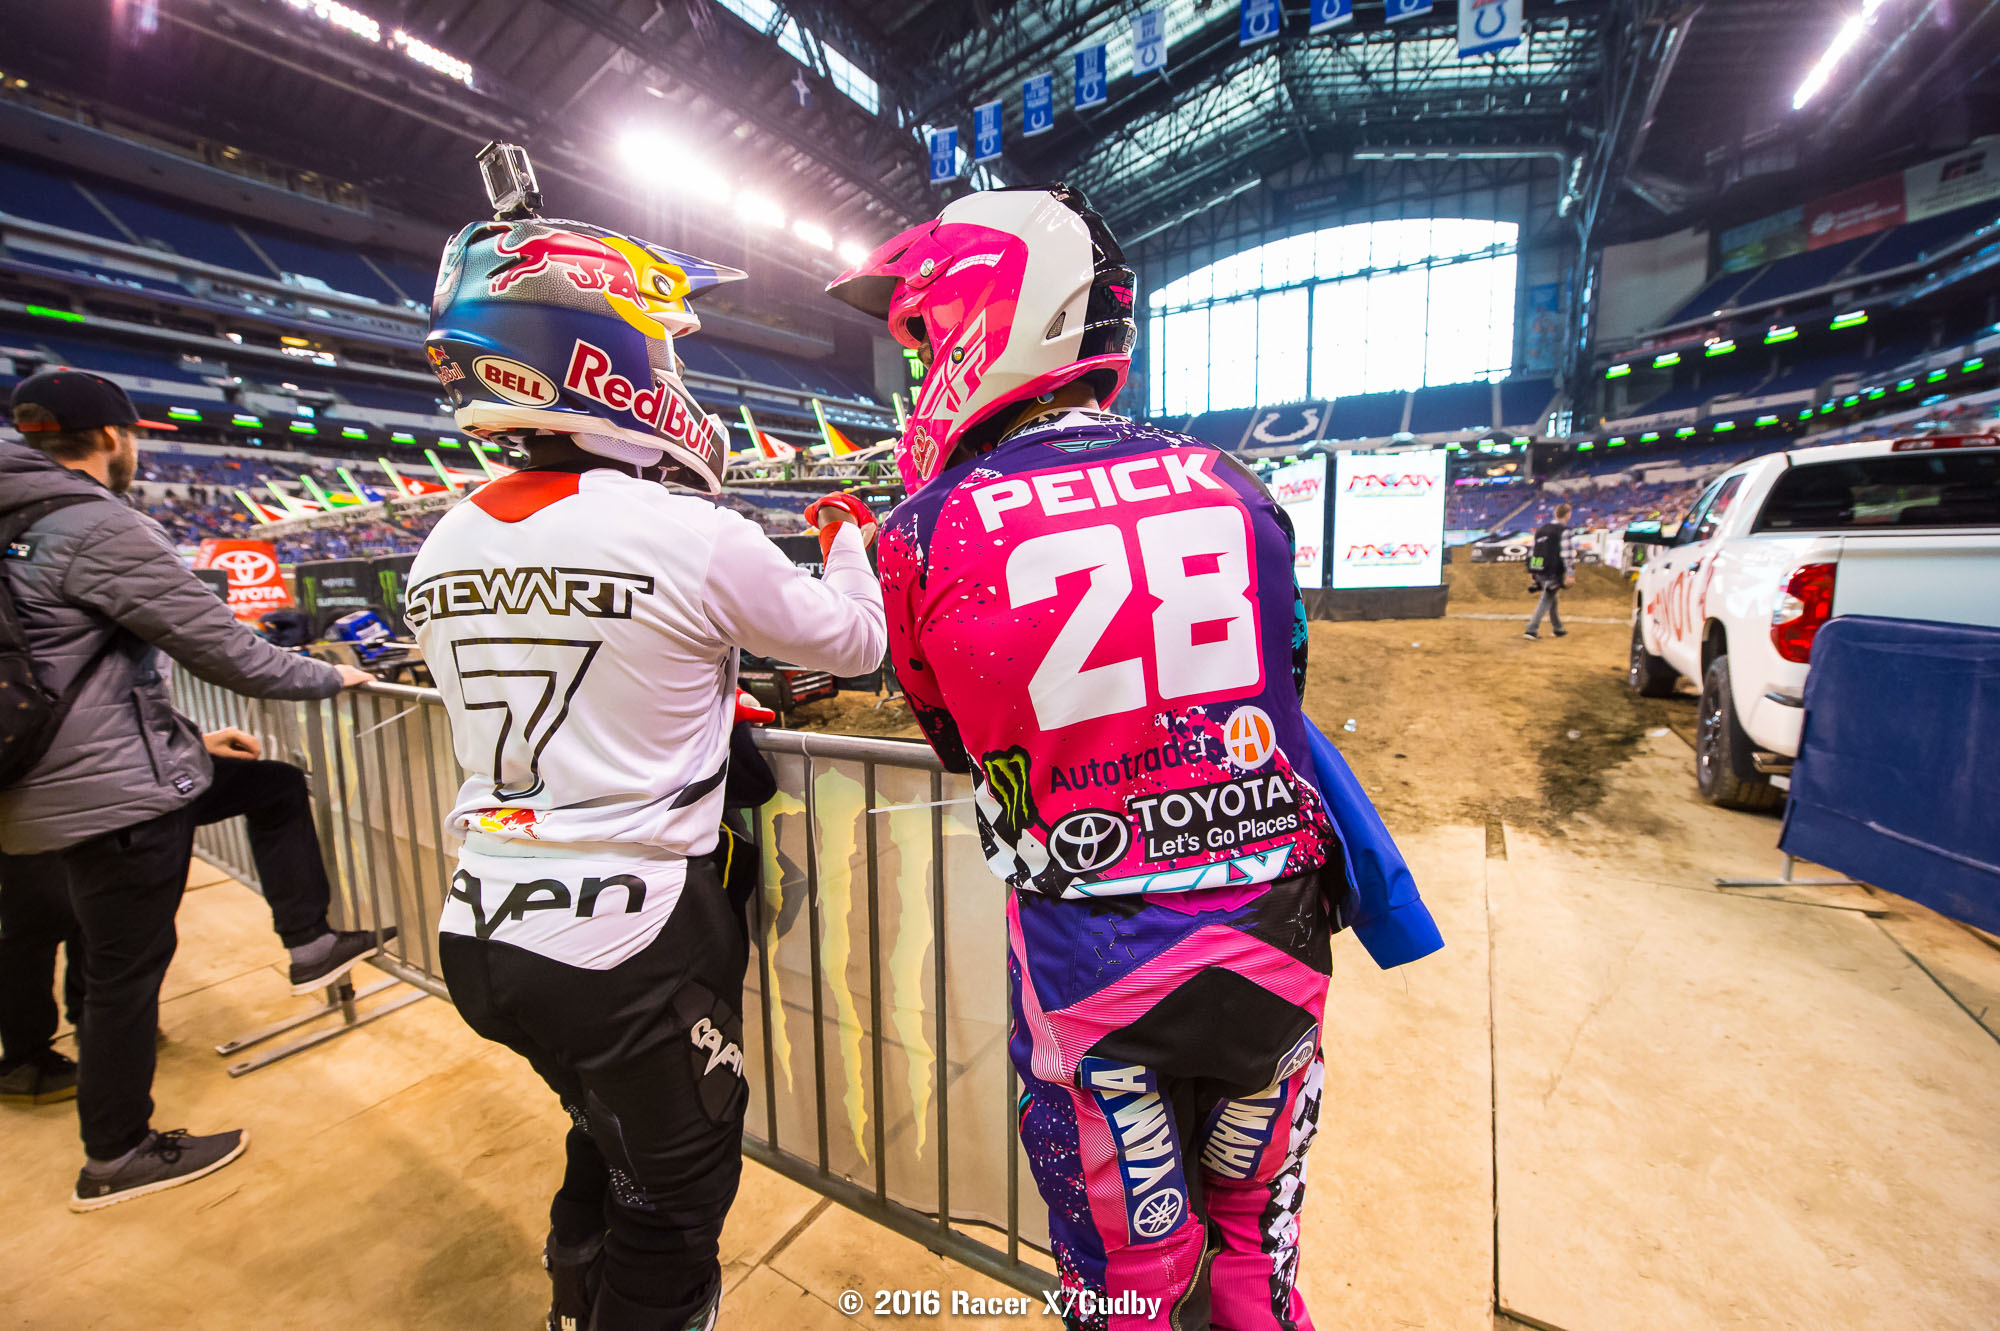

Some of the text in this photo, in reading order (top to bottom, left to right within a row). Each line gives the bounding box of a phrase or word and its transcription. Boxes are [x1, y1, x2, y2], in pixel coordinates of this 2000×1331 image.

[484, 363, 545, 401] BELL
[971, 453, 1224, 532] PEICK
[227, 586, 287, 602] OYOTA
[403, 567, 655, 628] STEWART
[1006, 505, 1261, 731] 28
[450, 638, 603, 801] 7
[1132, 775, 1294, 832] TOYOTA
[1150, 814, 1298, 858] Let's Go Places
[1091, 1065, 1175, 1196] YAMA
[1200, 1099, 1277, 1180] MAHA
